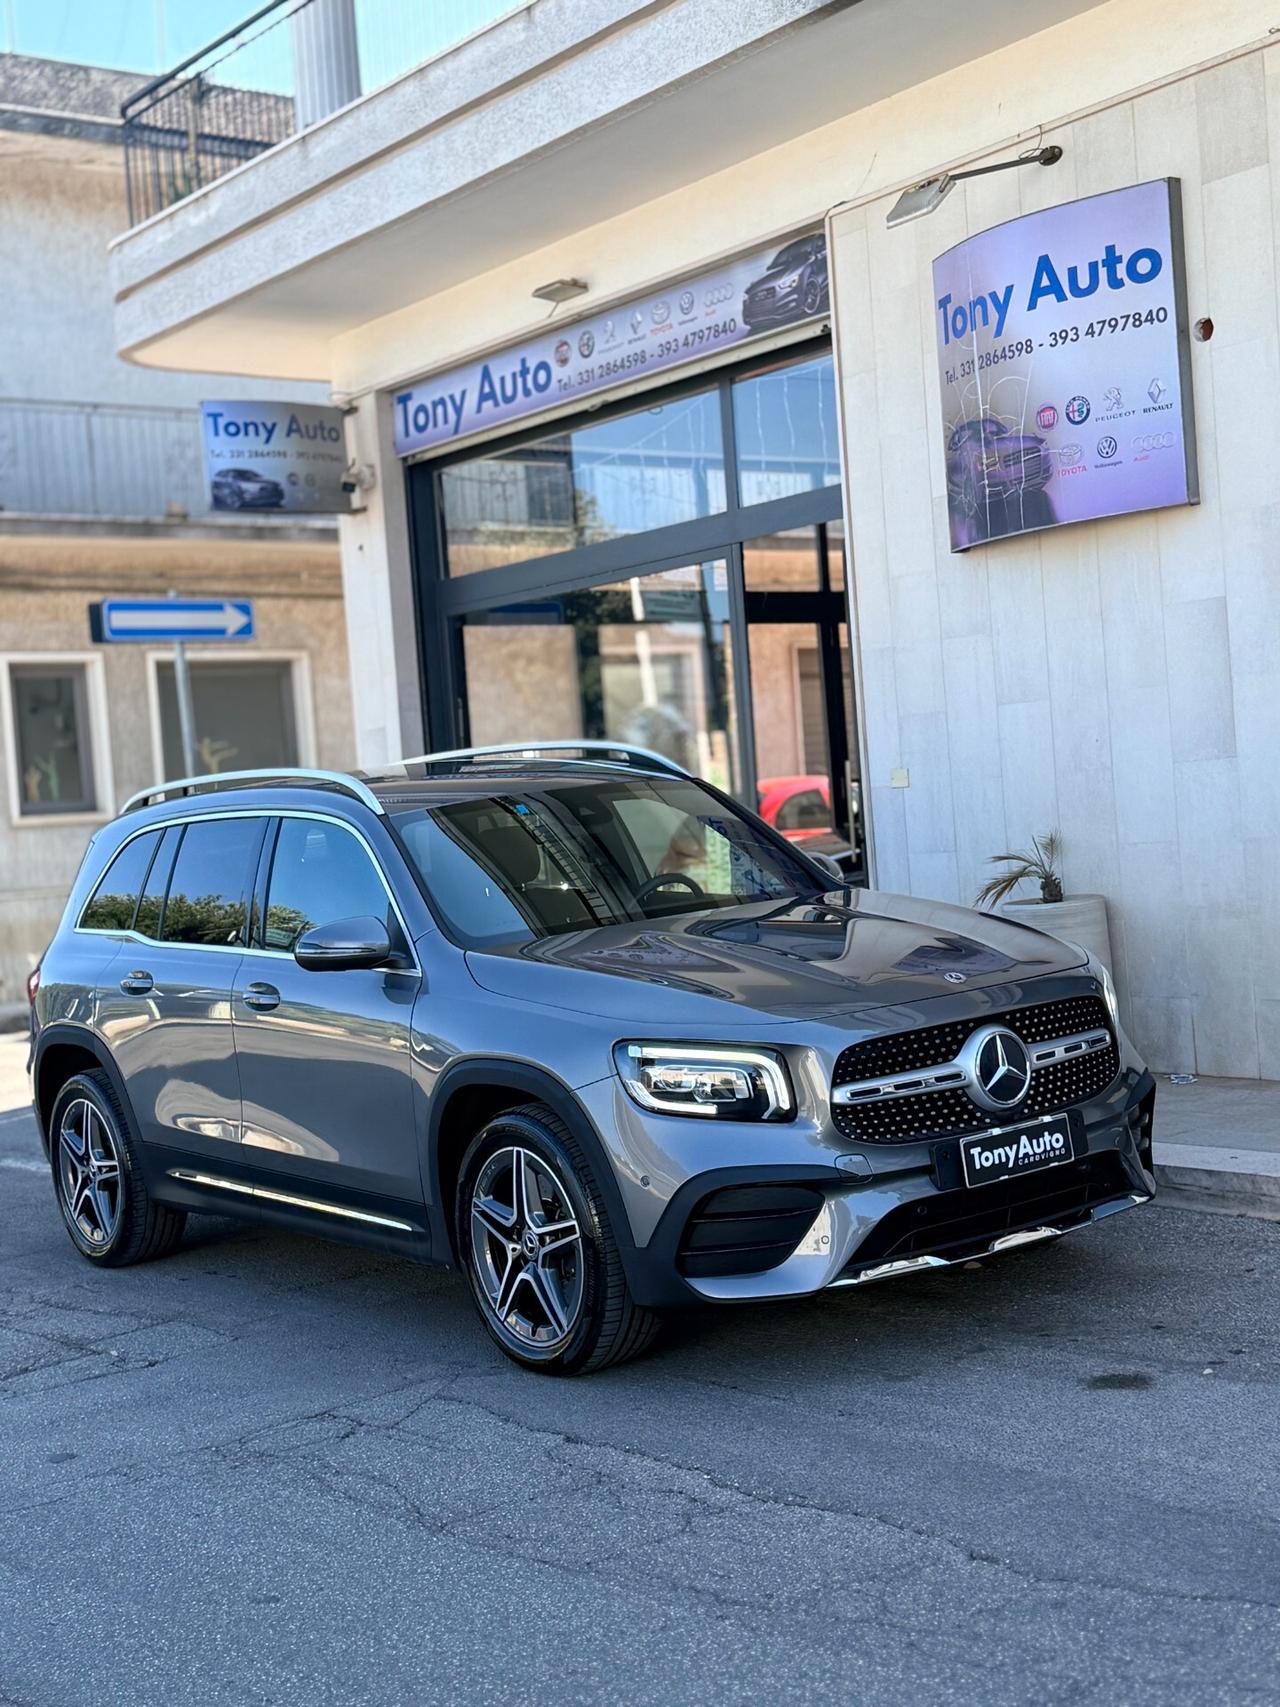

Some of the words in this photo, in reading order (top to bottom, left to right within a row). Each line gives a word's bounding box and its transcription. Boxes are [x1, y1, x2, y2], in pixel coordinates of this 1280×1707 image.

[938, 284, 1014, 345] Tony
[1026, 244, 1164, 312] Auto
[557, 377, 575, 393] Tel.
[577, 368, 595, 387] 331
[598, 350, 648, 380] 2864598
[657, 338, 680, 359] 393
[682, 317, 737, 349] 4797840
[946, 369, 960, 386] Tel.
[960, 359, 977, 379] 331
[978, 338, 1034, 371] 2864598
[1049, 326, 1080, 348] 393
[1085, 306, 1169, 338] 4797840
[396, 389, 467, 438] Tony
[475, 357, 552, 414] Auto
[1095, 410, 1136, 422] PEUGEOT
[1143, 402, 1174, 415] RENAULT
[206, 412, 278, 445] Tony
[286, 414, 341, 443] Auto
[1057, 465, 1088, 478] TOYOTA
